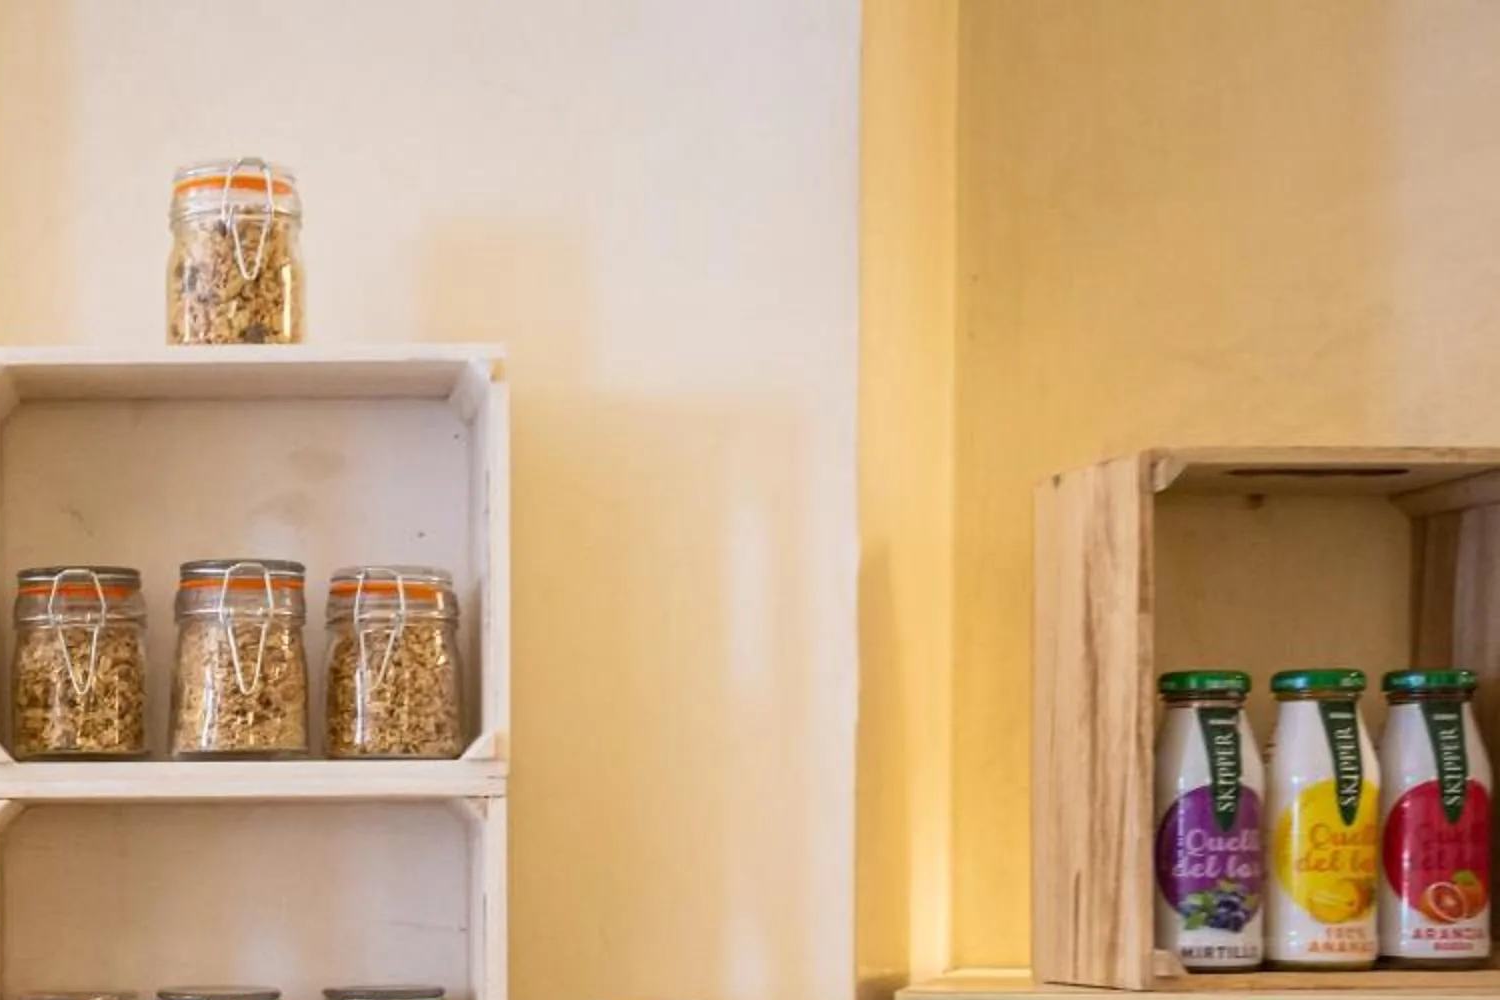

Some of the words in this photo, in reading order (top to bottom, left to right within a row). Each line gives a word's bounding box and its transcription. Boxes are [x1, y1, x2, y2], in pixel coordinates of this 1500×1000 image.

[1215, 732, 1236, 813] SKIPPER
[1334, 726, 1360, 806] SKIPPER
[1440, 726, 1462, 806] SKIPPER
